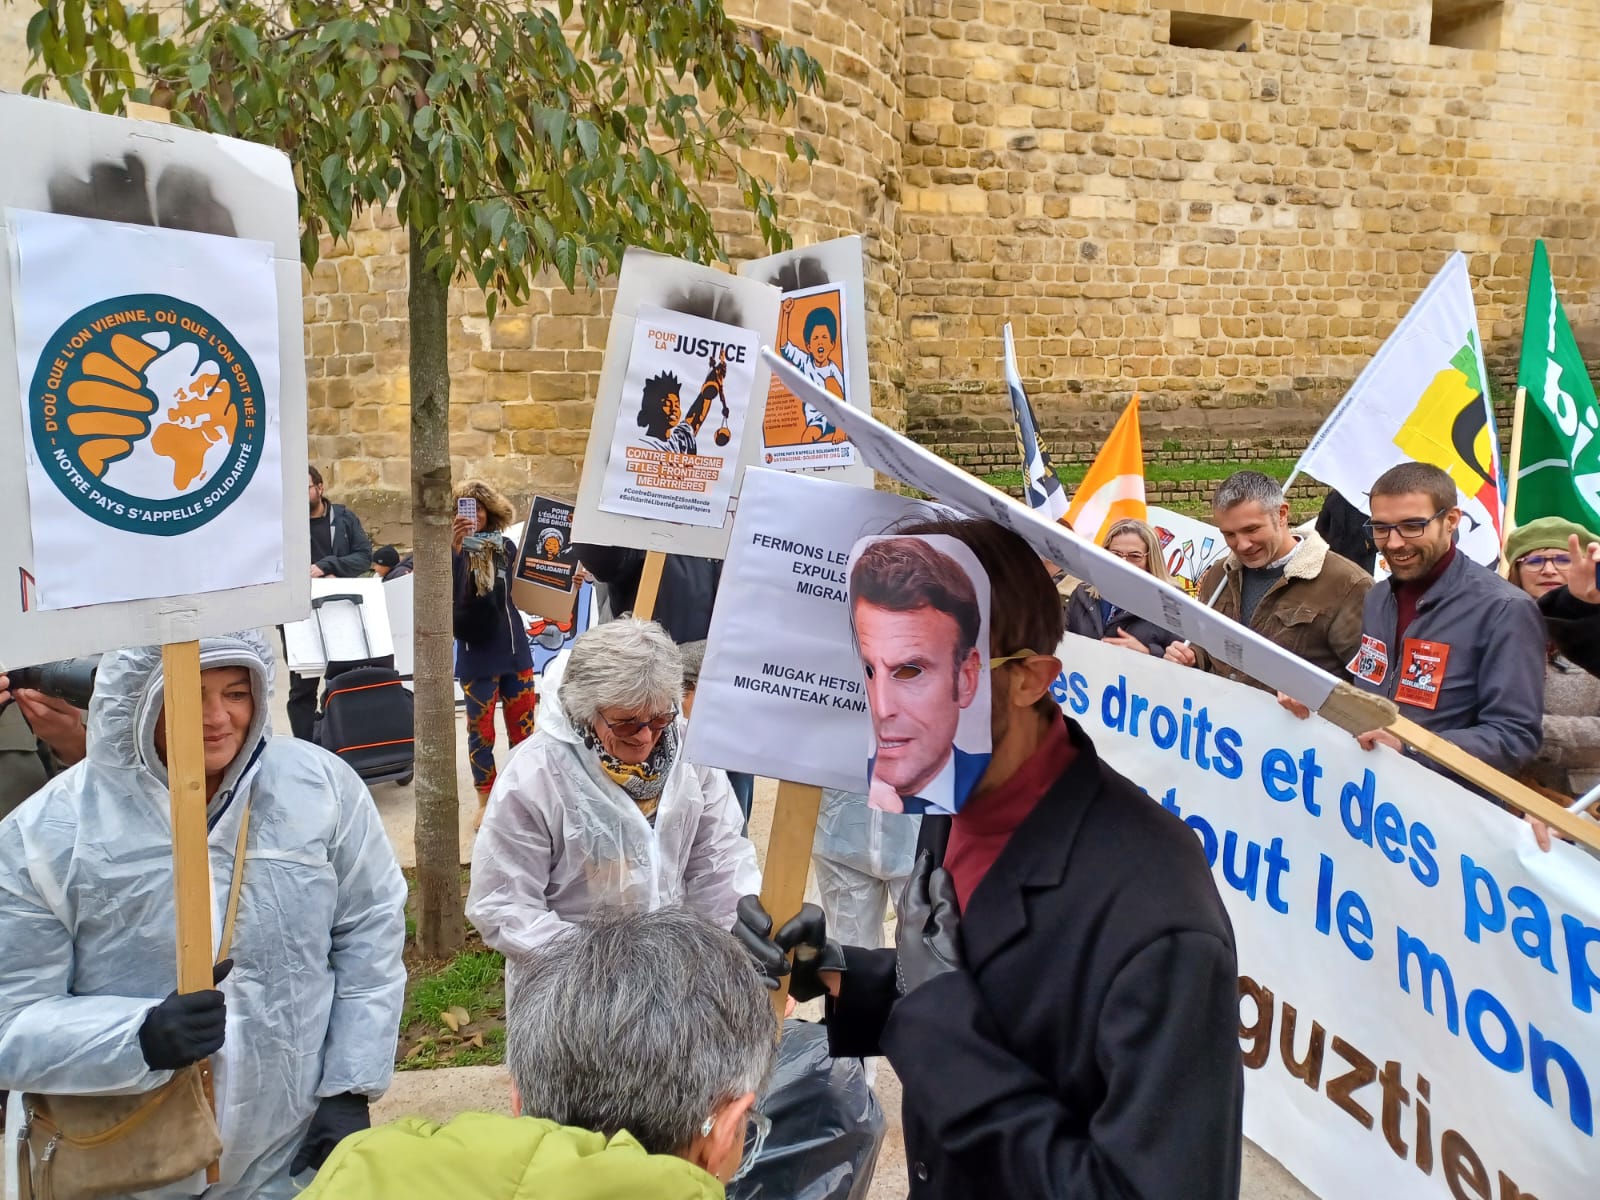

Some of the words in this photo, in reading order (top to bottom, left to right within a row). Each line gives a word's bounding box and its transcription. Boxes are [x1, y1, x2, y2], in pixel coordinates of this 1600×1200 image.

[90, 309, 151, 333] VIENNE,
[155, 310, 177, 324] OÙ
[181, 317, 208, 339] QUE
[61, 328, 93, 358] L'ON
[208, 335, 235, 363] L'ON
[648, 329, 676, 343] POUR
[674, 335, 746, 363] JUSTICE
[655, 341, 667, 350] LA
[47, 358, 68, 389] QUE
[231, 363, 251, 393] SOIT
[41, 394, 58, 431] D'OÙ
[627, 449, 666, 462] CONTRE
[668, 453, 679, 462] LE
[682, 455, 722, 468] RACISME
[627, 461, 640, 471] ET
[641, 463, 658, 473] LES
[54, 449, 91, 494] NOTRE
[88, 490, 125, 515] PAYS
[128, 502, 203, 522] S'APPELLE
[203, 442, 252, 507] SOLIDARITÉ
[552, 507, 569, 516] POUR
[752, 533, 824, 560] FERMONS
[792, 561, 847, 585] EXPULS
[733, 675, 828, 706] MIGRANTEAK
[762, 663, 816, 685] MUGAK
[819, 674, 860, 694] HETSI
[1101, 674, 1243, 780] droits
[1261, 747, 1323, 818] et
[1339, 768, 1440, 887] des
[1315, 853, 1374, 961] le
[1397, 926, 1594, 1136] mon
